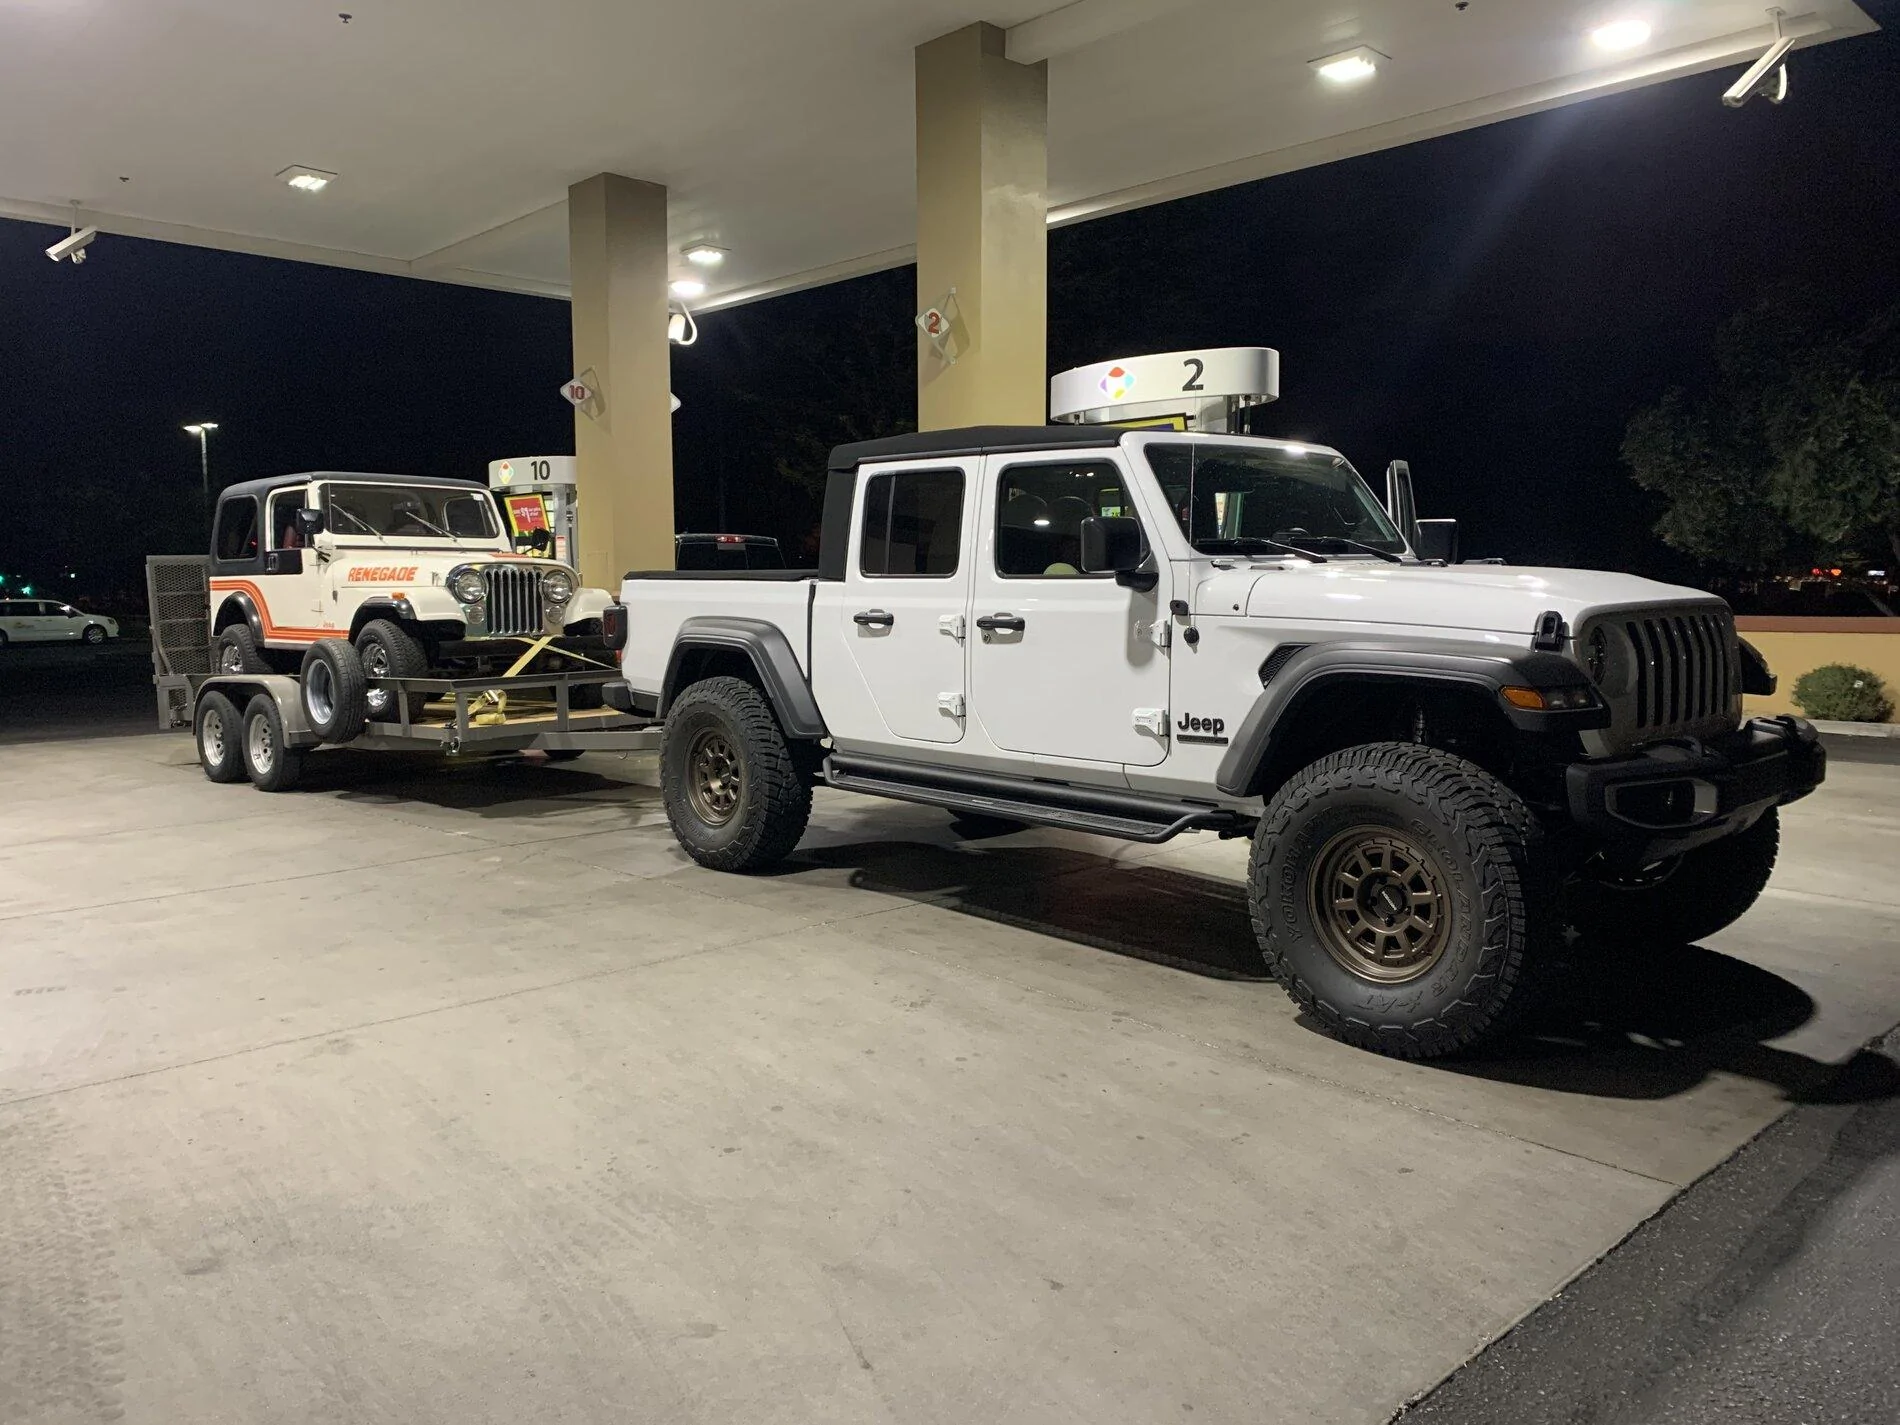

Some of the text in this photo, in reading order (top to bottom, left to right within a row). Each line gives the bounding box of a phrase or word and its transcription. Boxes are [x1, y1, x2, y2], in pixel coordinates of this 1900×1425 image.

[928, 312, 939, 334] 2
[1182, 358, 1204, 391] 2
[569, 385, 585, 400] 10
[531, 460, 550, 480] 10
[348, 567, 418, 581] RENEGADE
[1177, 712, 1225, 735] Jeep
